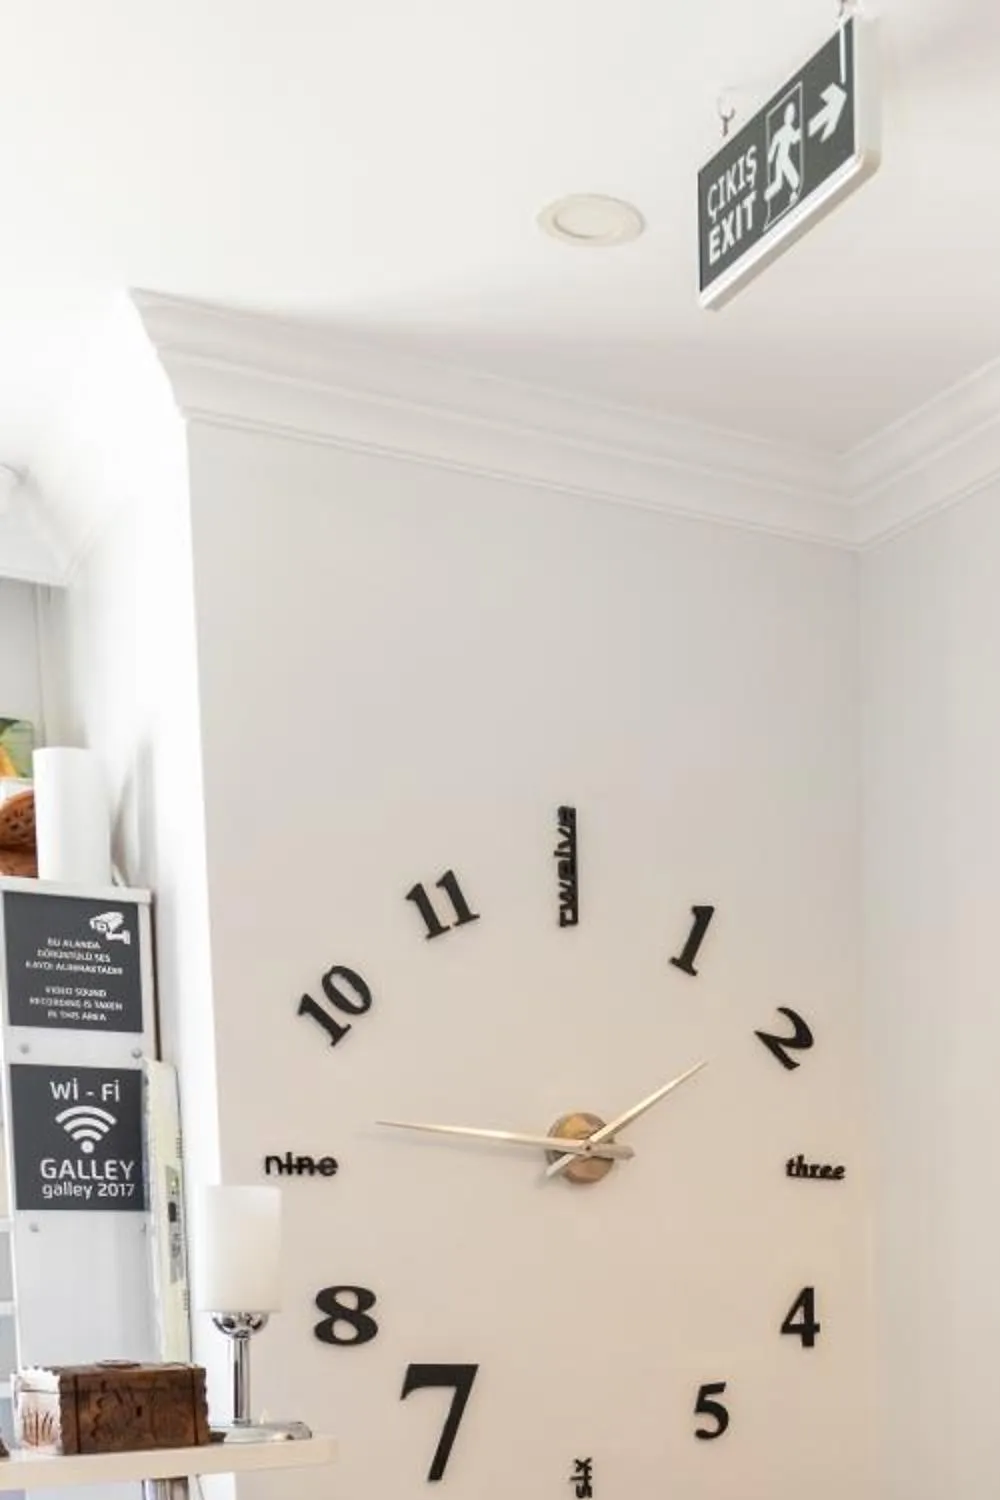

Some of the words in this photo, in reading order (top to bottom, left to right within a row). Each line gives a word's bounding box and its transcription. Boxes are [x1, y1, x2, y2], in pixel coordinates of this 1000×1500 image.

[708, 190, 757, 266] EXIT
[406, 869, 480, 939] 11
[669, 905, 715, 976] 1
[298, 965, 372, 1047] 10
[755, 1007, 814, 1070] 2
[40, 1158, 135, 1180] GALLEY
[42, 1181, 93, 1200] galley
[97, 1183, 135, 1197] 2017
[265, 1151, 338, 1177] nine
[786, 1155, 845, 1180] three
[313, 1285, 379, 1346] 8
[780, 1286, 820, 1348] 4
[400, 1363, 479, 1482] 7
[694, 1381, 729, 1440] 5
[570, 1457, 593, 1500] six
